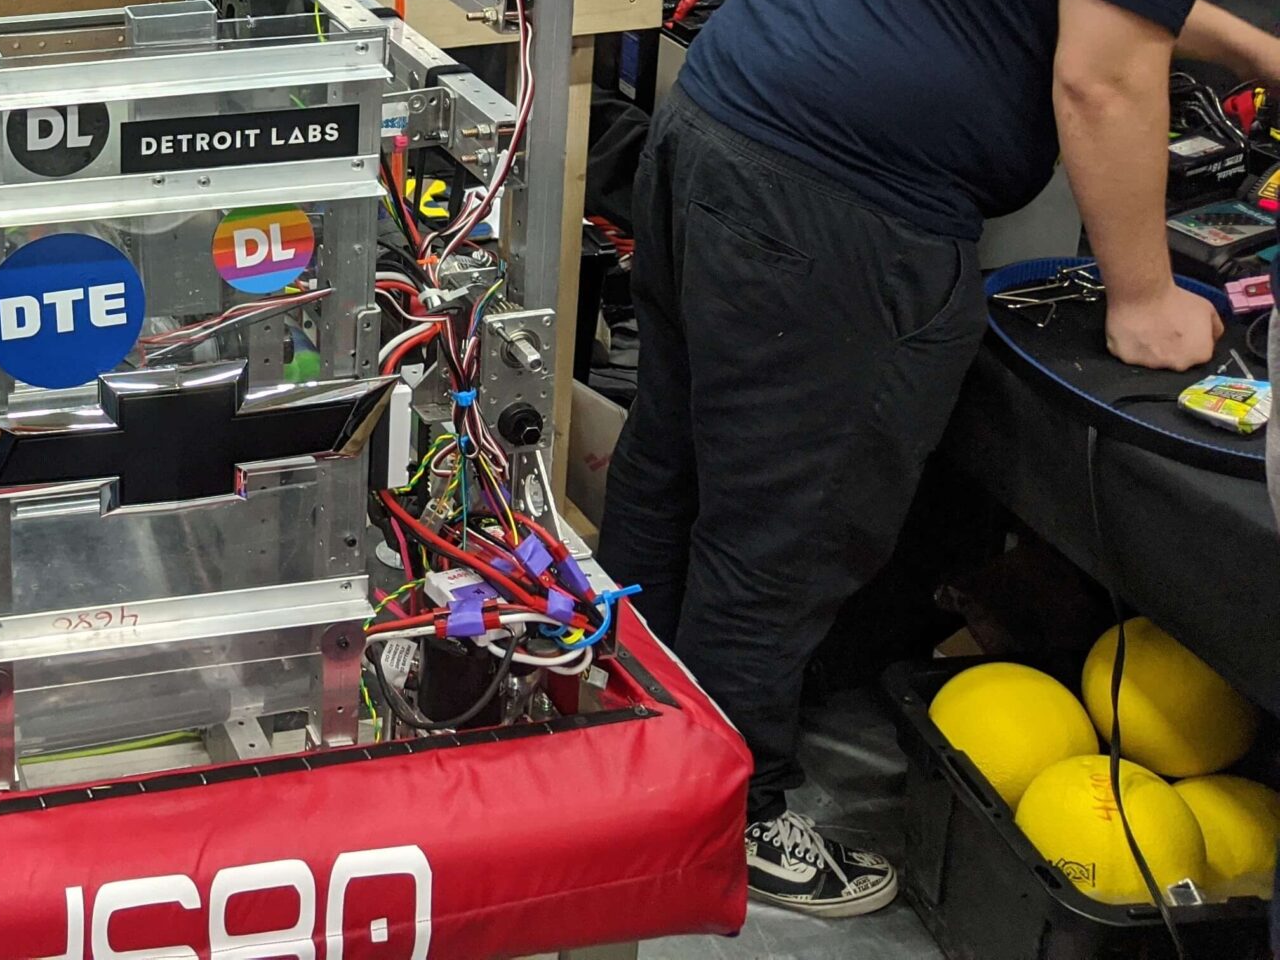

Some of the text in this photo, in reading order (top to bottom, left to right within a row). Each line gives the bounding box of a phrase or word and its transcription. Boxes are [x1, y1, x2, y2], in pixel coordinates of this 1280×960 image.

[26, 106, 94, 152] DL
[140, 122, 340, 156] DETROIT LABS
[233, 223, 297, 269] DL
